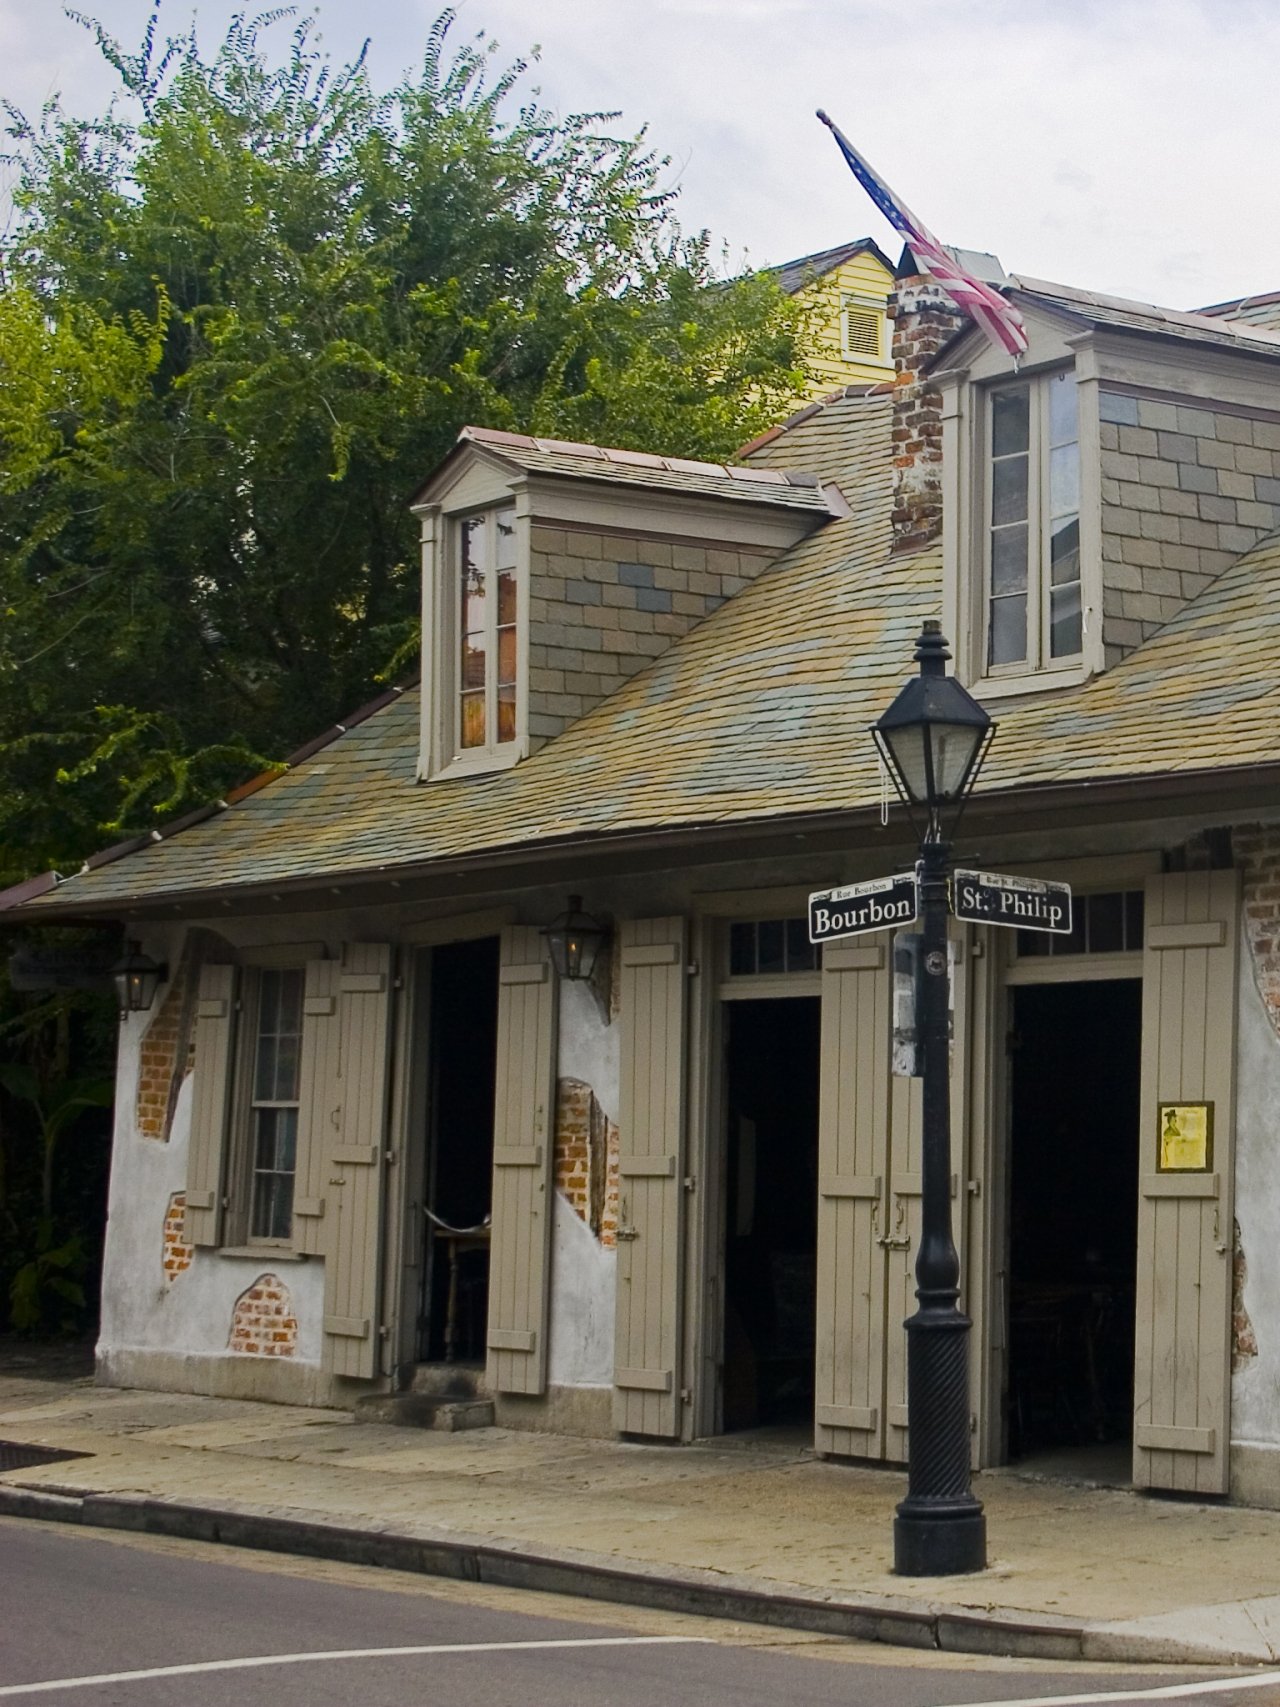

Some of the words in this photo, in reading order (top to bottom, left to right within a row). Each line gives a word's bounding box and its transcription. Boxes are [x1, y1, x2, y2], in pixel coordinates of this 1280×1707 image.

[836, 890, 851, 900] Rue
[854, 882, 888, 896] Bourbon
[962, 886, 989, 912] St.
[1000, 891, 1063, 928] Philip
[814, 898, 911, 934] Bourbon
